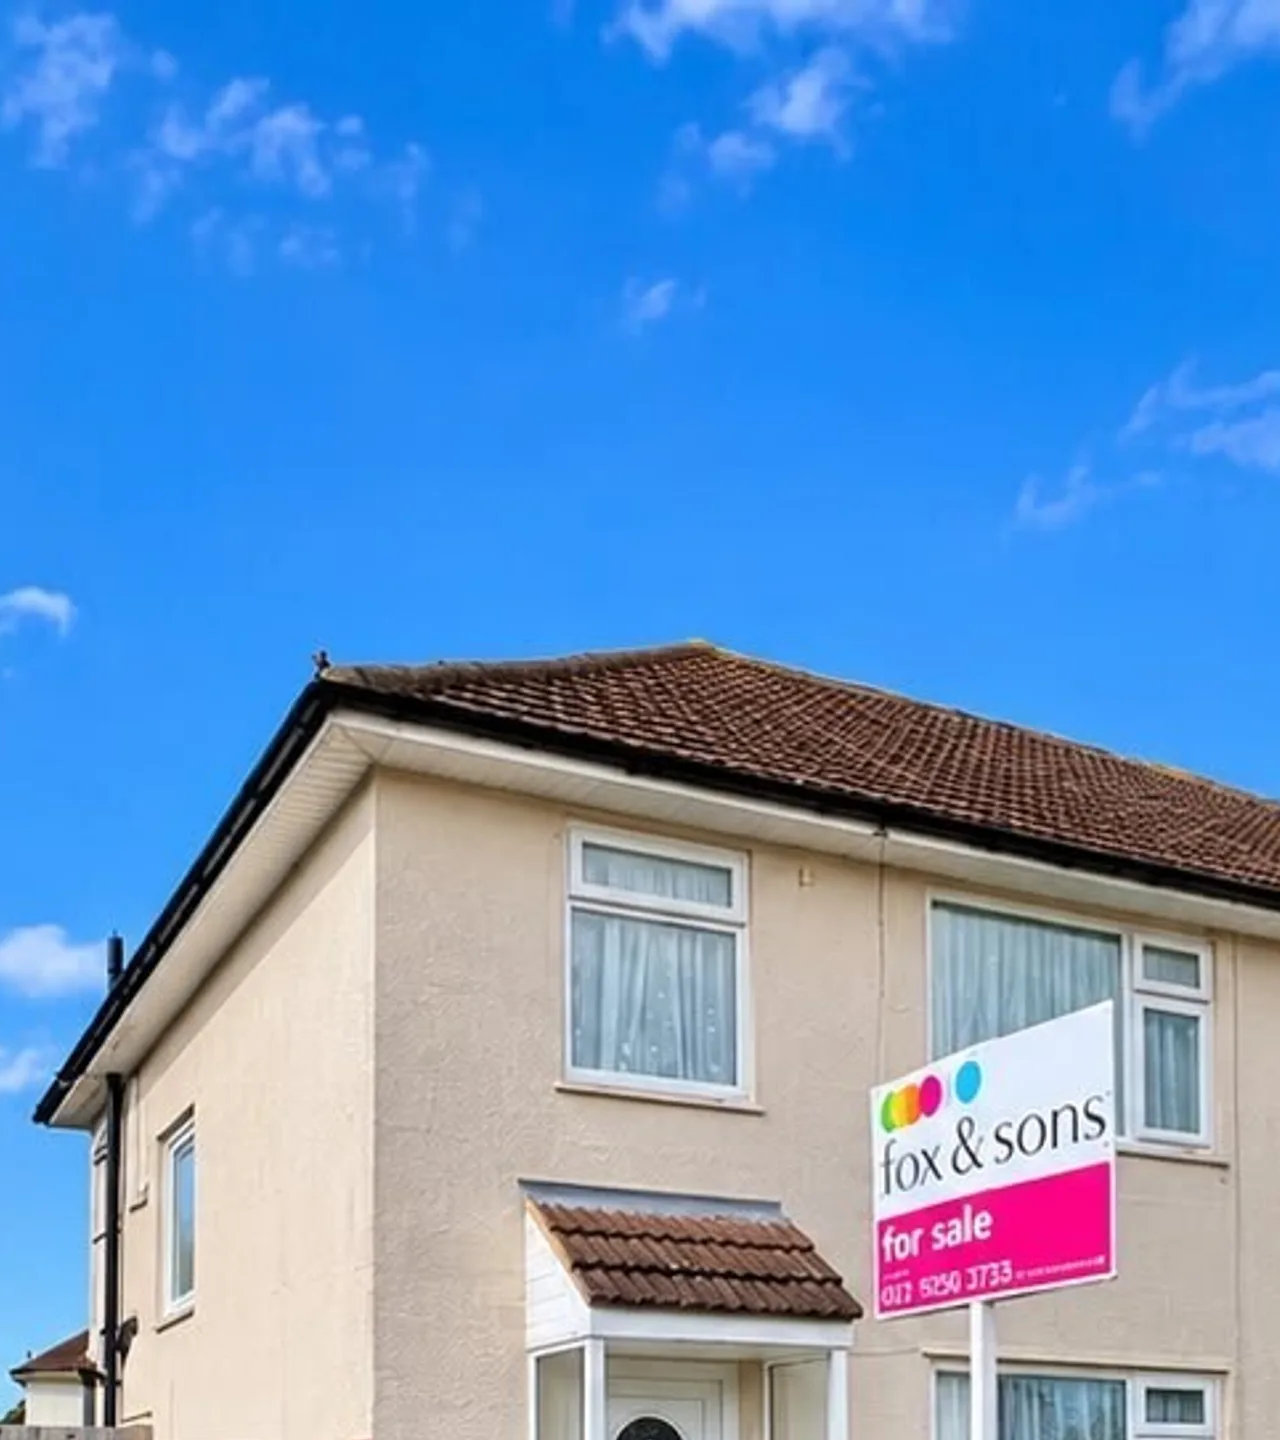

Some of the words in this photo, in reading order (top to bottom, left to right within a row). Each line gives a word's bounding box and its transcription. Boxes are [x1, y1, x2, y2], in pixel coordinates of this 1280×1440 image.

[880, 1138, 943, 1195] fox
[951, 1116, 984, 1176] &
[993, 1095, 1107, 1165] sons
[882, 1225, 925, 1263] for
[931, 1203, 993, 1251] sale
